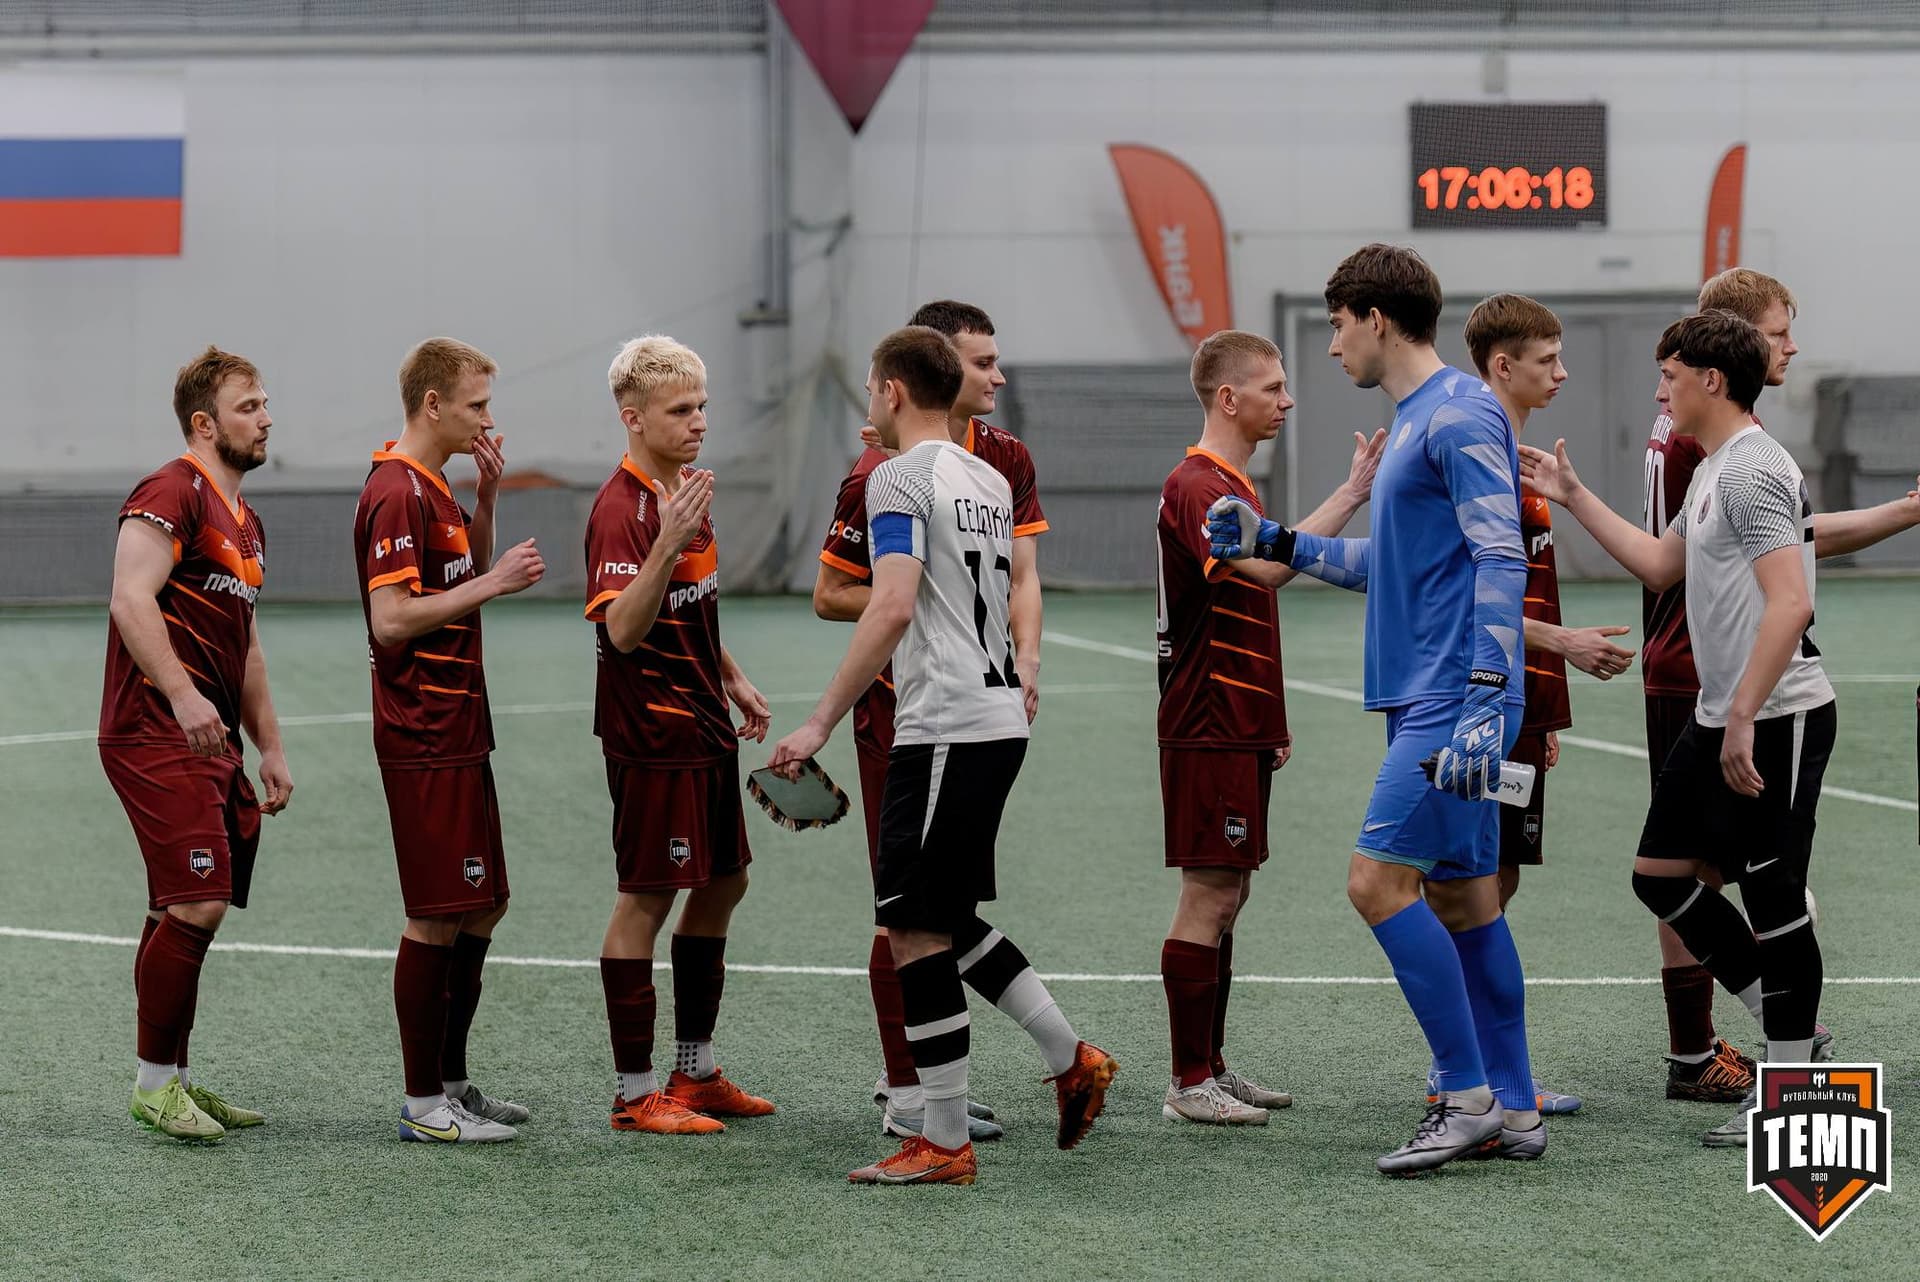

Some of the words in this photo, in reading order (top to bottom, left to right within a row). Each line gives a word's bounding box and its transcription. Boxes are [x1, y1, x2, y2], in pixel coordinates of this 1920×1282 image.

[395, 535, 414, 552] ПС
[841, 526, 863, 544] СБ
[1532, 530, 1553, 556] ПР
[604, 561, 639, 576] ПСБ
[1470, 670, 1504, 684] SPORT
